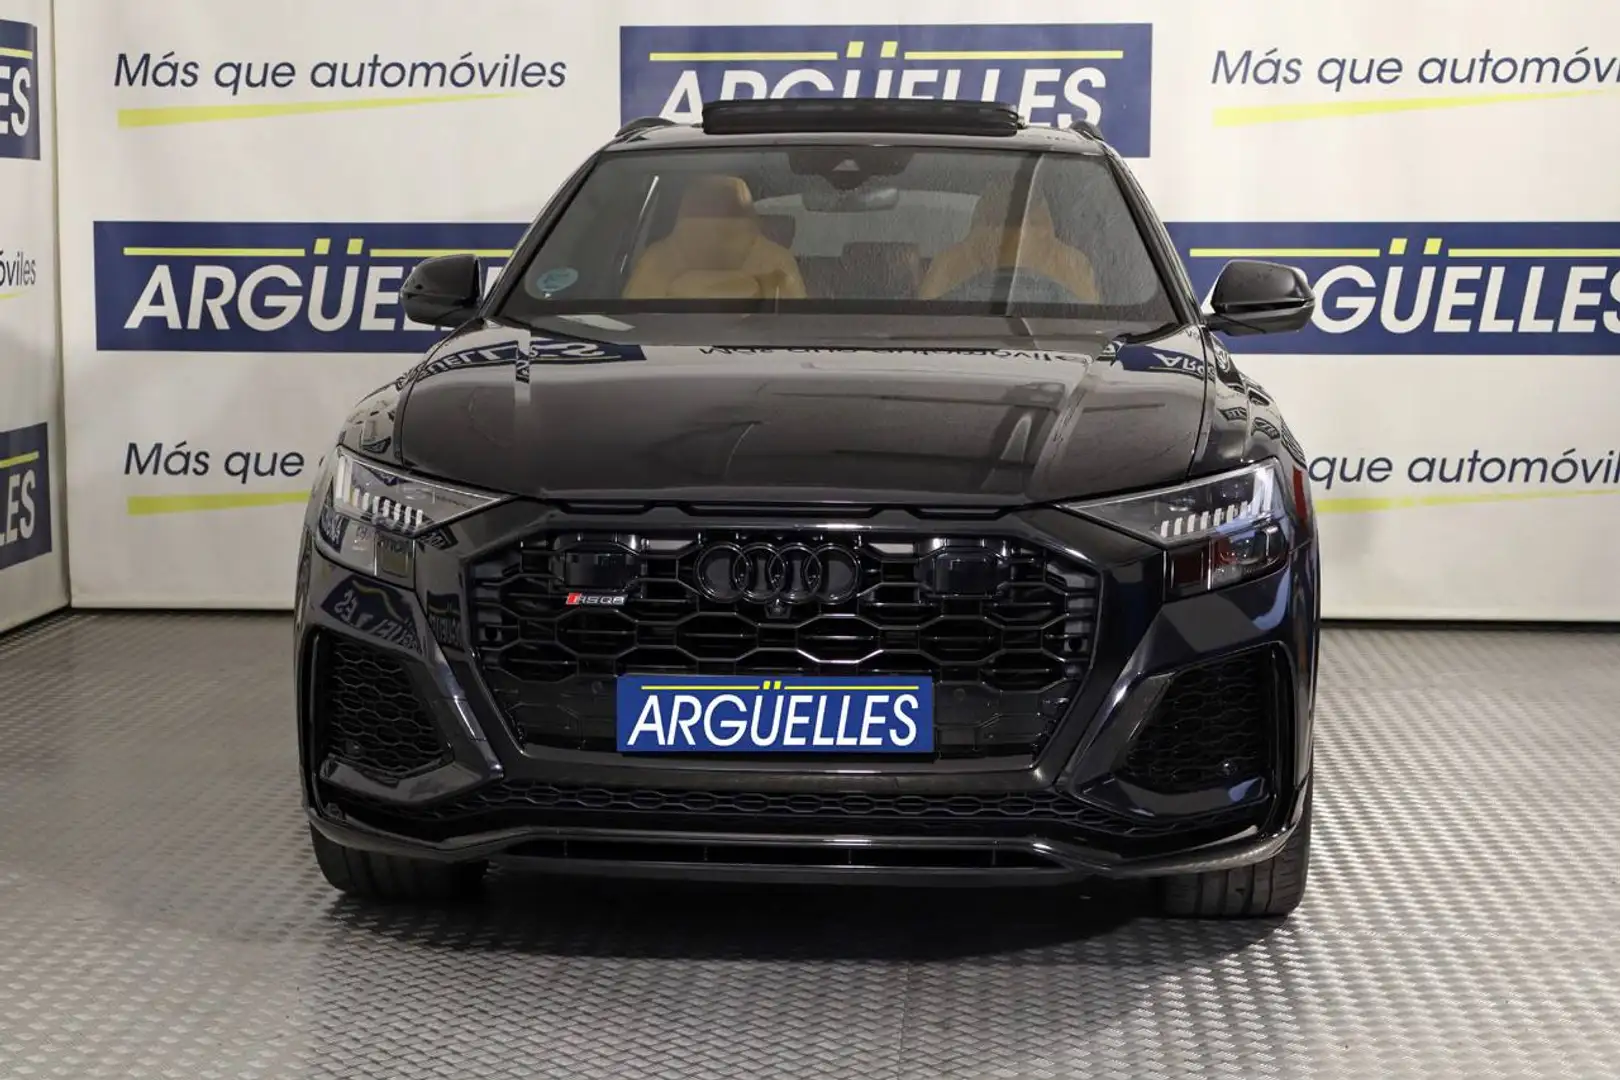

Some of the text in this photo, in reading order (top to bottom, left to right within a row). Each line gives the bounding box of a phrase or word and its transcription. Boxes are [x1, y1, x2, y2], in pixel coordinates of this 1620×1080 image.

[113, 50, 568, 96] Más que automóviles
[1211, 47, 1303, 85] Más
[1317, 56, 1404, 92] que
[124, 440, 305, 485] Más que
[1308, 456, 1393, 490] que
[0, 469, 36, 546] ES
[627, 681, 919, 747] ARGÜELLES
